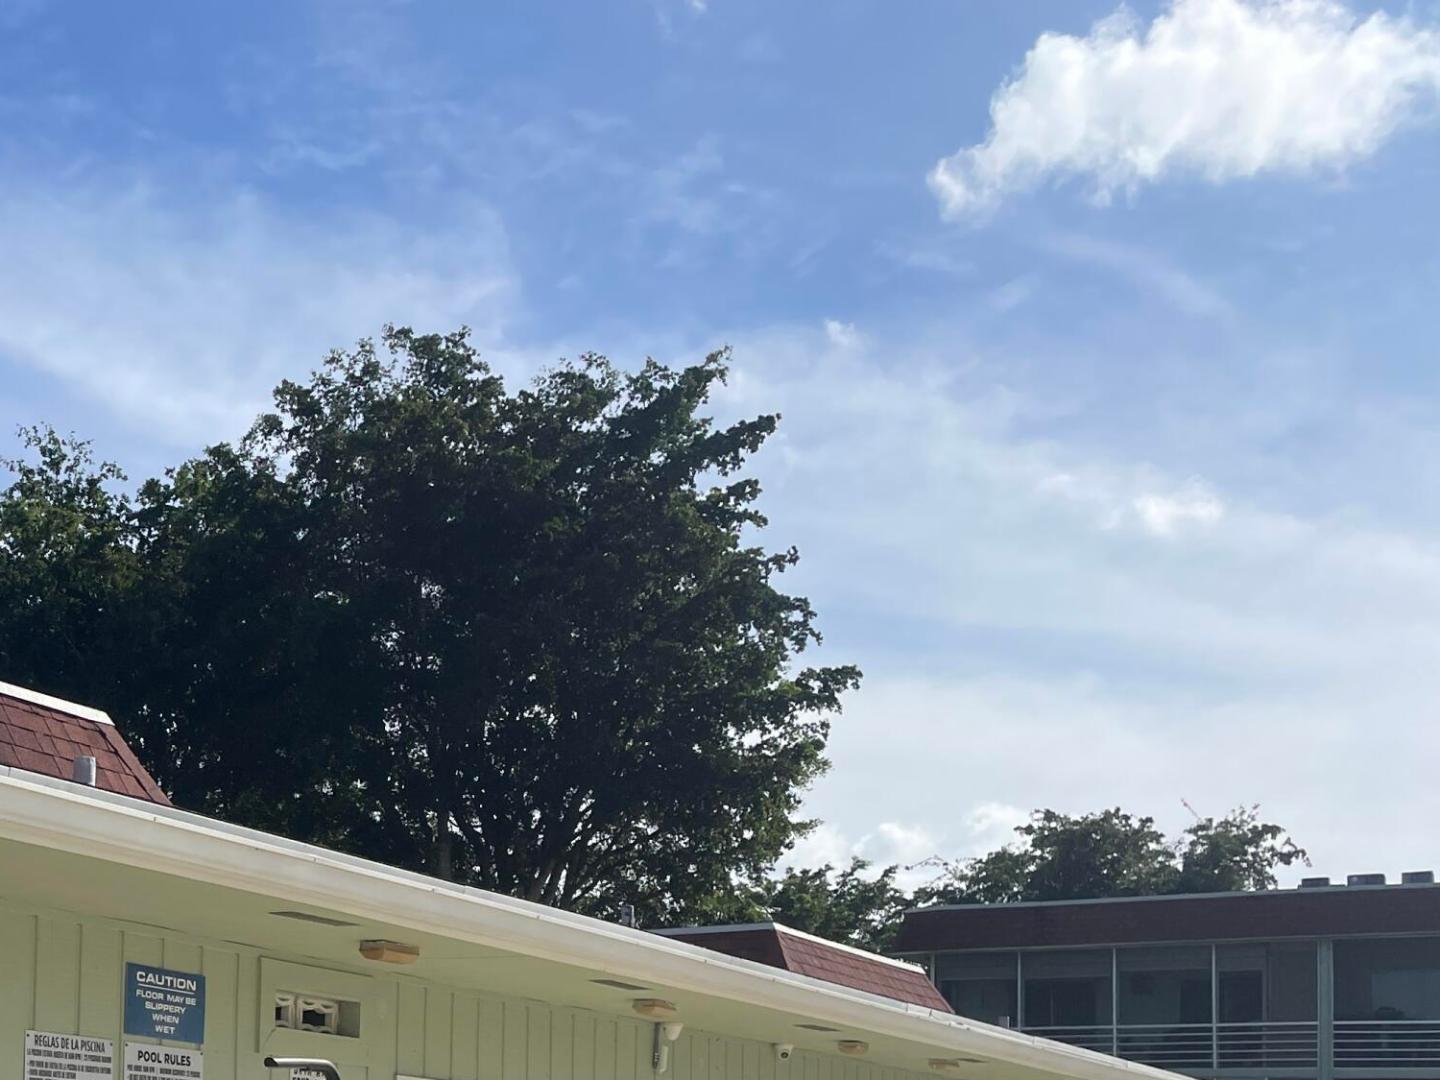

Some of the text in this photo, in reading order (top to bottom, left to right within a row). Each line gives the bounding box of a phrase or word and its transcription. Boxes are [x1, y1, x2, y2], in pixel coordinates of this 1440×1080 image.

[136, 971, 197, 991] CAUTION
[136, 989, 197, 1006] FLOOR MAY BE
[145, 1001, 186, 1014] SLIPPERY
[152, 1013, 179, 1024] WHEN
[155, 1024, 176, 1034] WET
[34, 1034, 106, 1053] REGLAS DE LA PISCINA
[137, 1050, 191, 1067] POOL RULES
